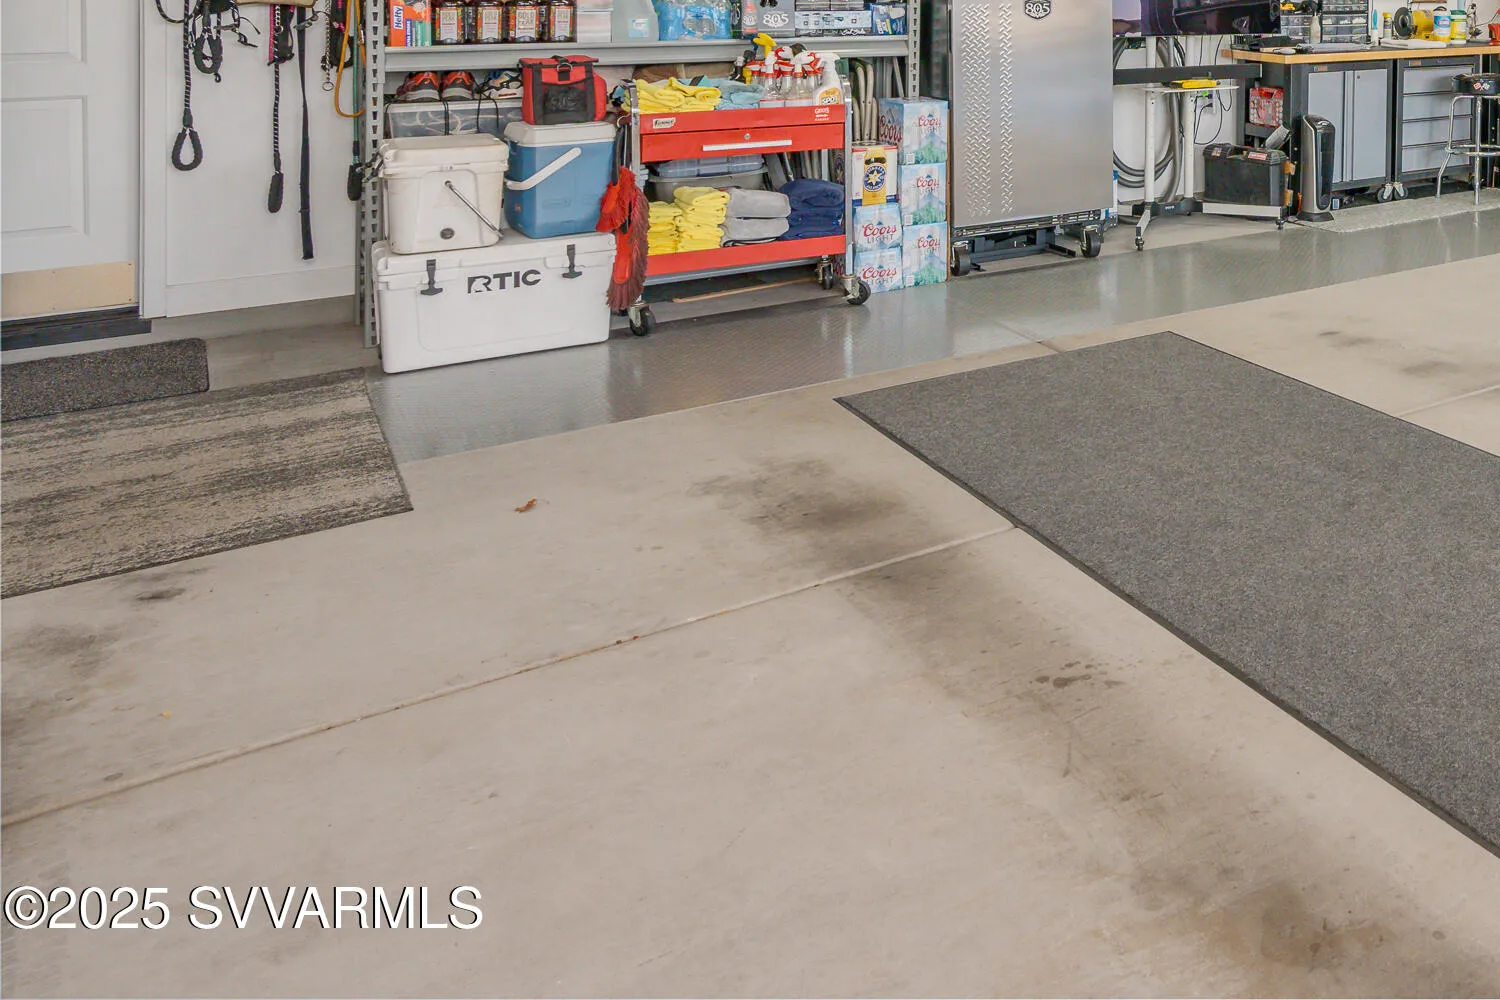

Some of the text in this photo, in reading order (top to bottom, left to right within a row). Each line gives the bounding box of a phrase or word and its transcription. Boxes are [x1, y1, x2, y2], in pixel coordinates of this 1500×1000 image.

[1025, 2, 1050, 16] 805
[394, 6, 403, 29] Hefty
[762, 13, 790, 25] 805
[862, 225, 897, 237] Coors
[866, 235, 895, 244] LIGHT
[861, 267, 897, 280] Coors
[467, 269, 542, 294] RTIC
